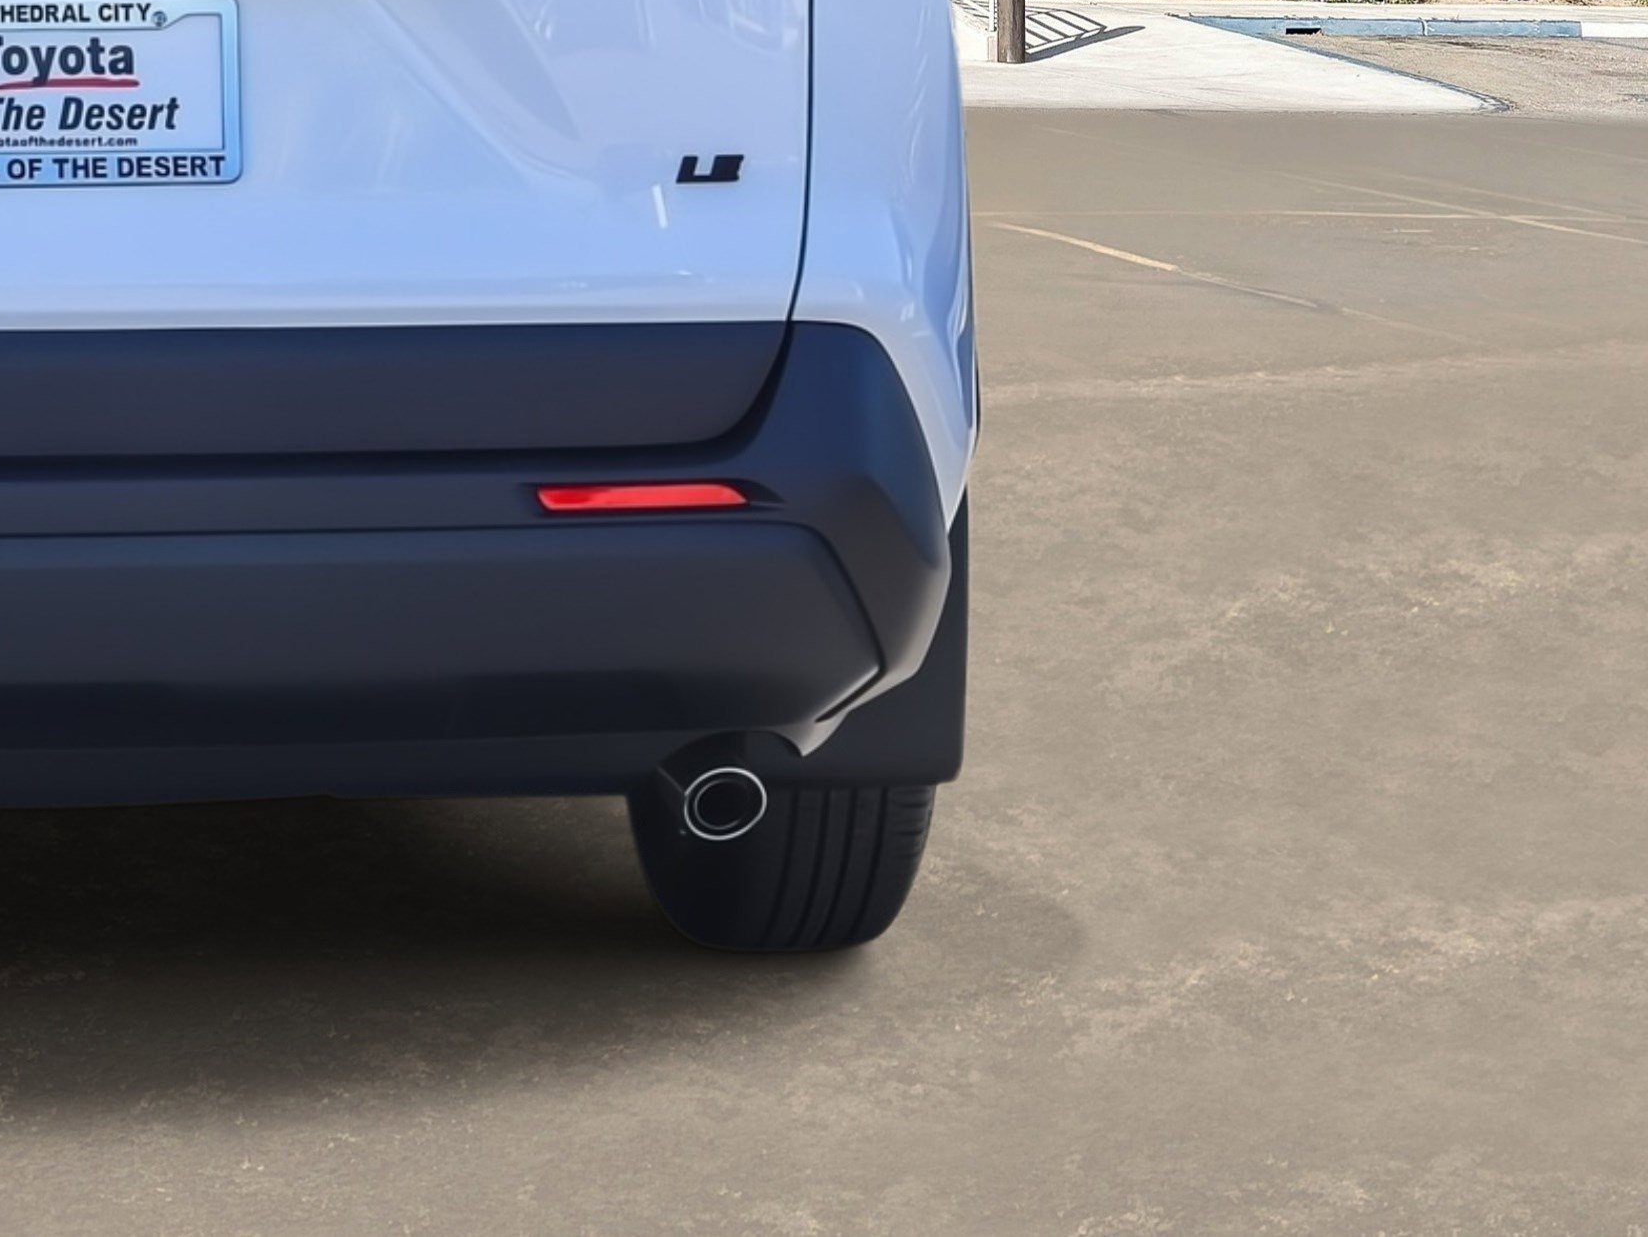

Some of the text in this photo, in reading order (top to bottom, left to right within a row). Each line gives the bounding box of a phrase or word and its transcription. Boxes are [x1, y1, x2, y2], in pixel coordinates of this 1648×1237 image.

[98, 3, 152, 22] CITY
[58, 96, 180, 131] Desert
[7, 158, 43, 180] OF
[53, 156, 108, 179] THE
[117, 155, 226, 178] DESERT
[675, 154, 745, 184] LE
